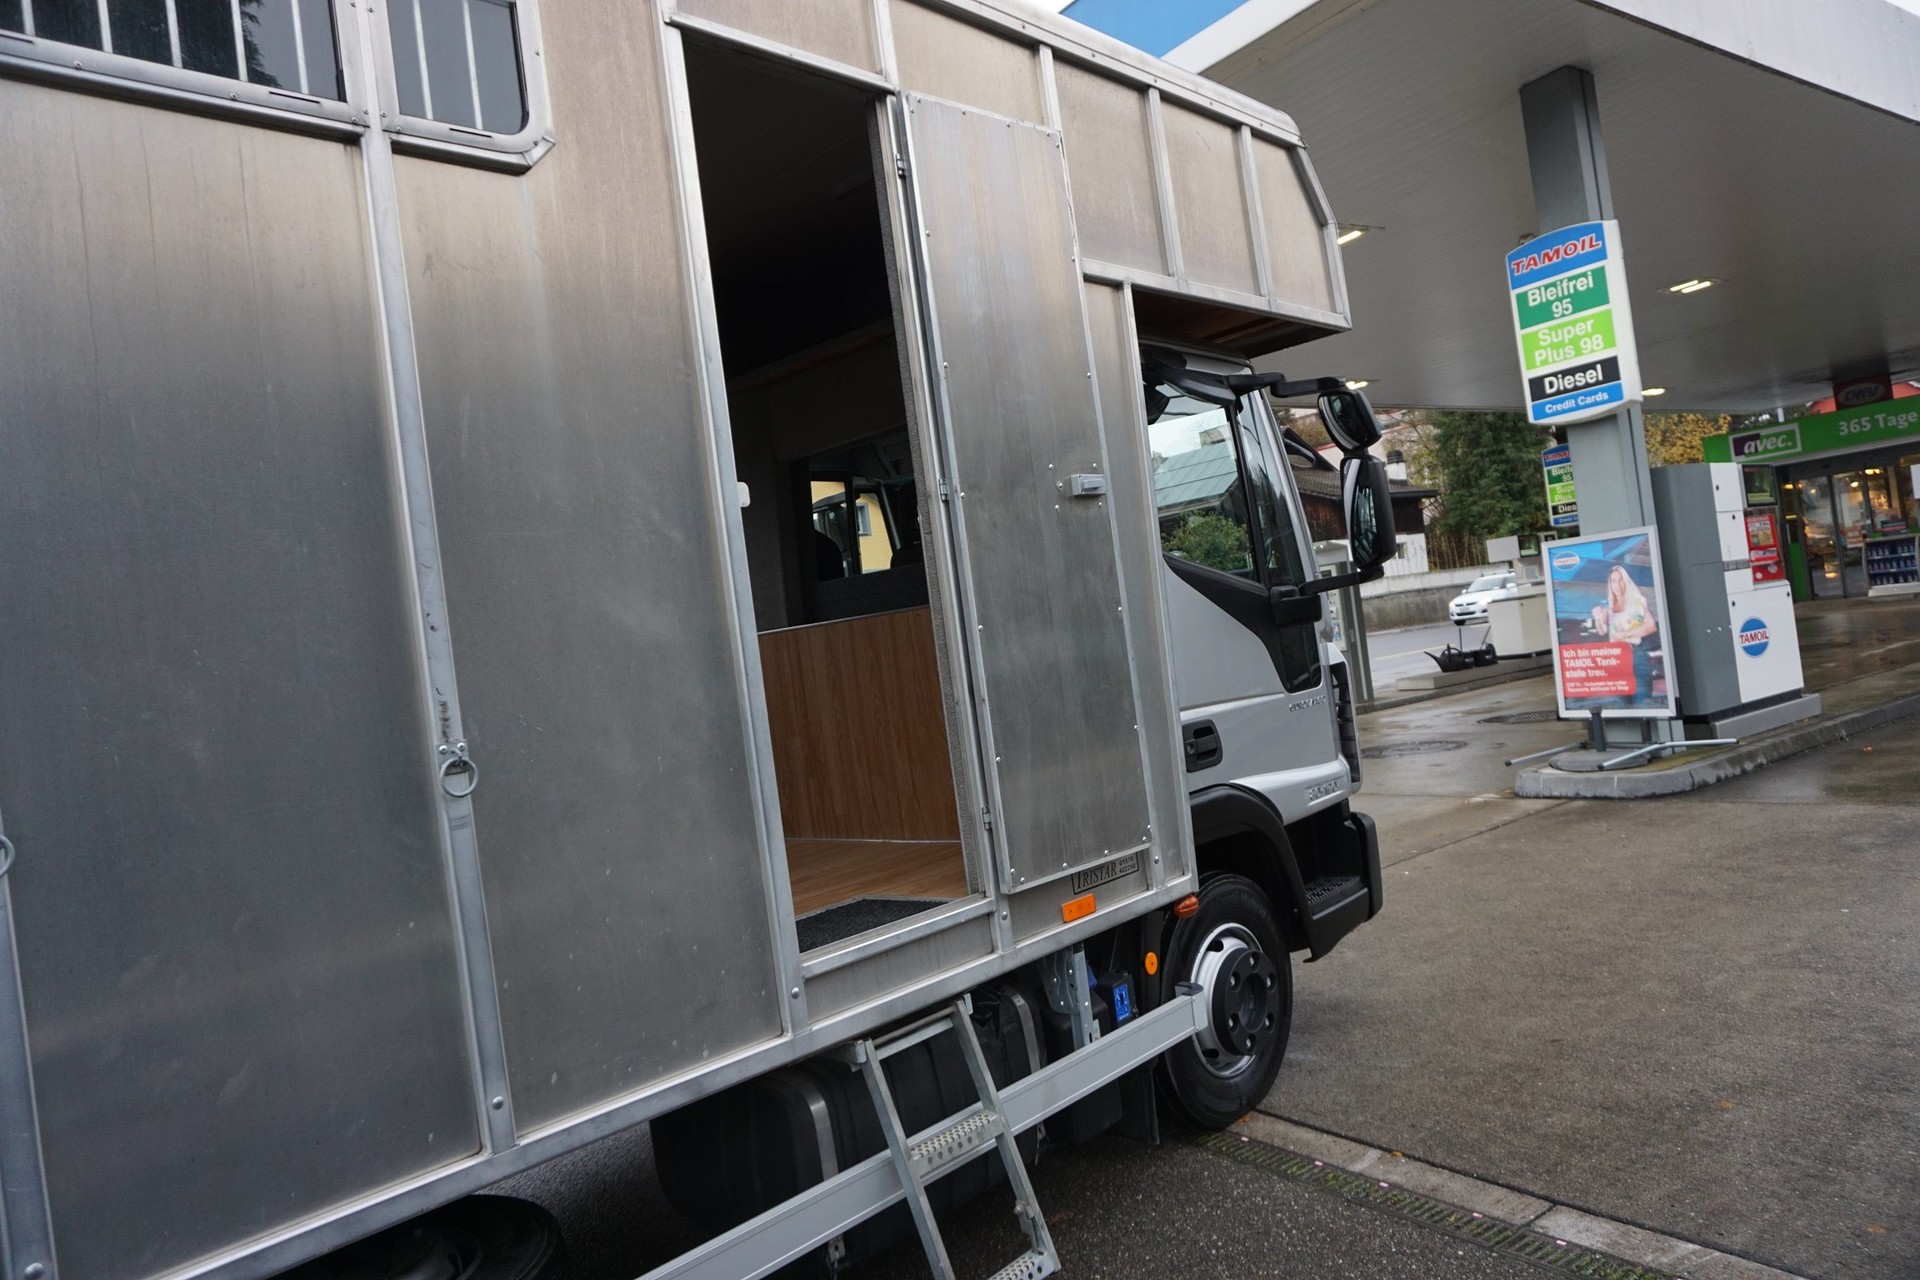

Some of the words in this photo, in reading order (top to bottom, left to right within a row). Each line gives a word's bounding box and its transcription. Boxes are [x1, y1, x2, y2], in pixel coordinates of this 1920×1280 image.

[1512, 233, 1602, 276] TAMOIL
[1527, 271, 1594, 307] Bleifrei
[1552, 300, 1573, 318] 95
[1538, 319, 1594, 346] Super
[1535, 343, 1575, 367] Plus
[1580, 334, 1604, 355] 98
[1544, 364, 1603, 394] Diesel
[1545, 398, 1575, 413] Credit
[1578, 391, 1609, 406] Cards
[1838, 416, 1871, 436] 365
[1874, 411, 1918, 429] Tage
[1558, 504, 1577, 513] Dies
[1739, 629, 1769, 645] TAMOIL
